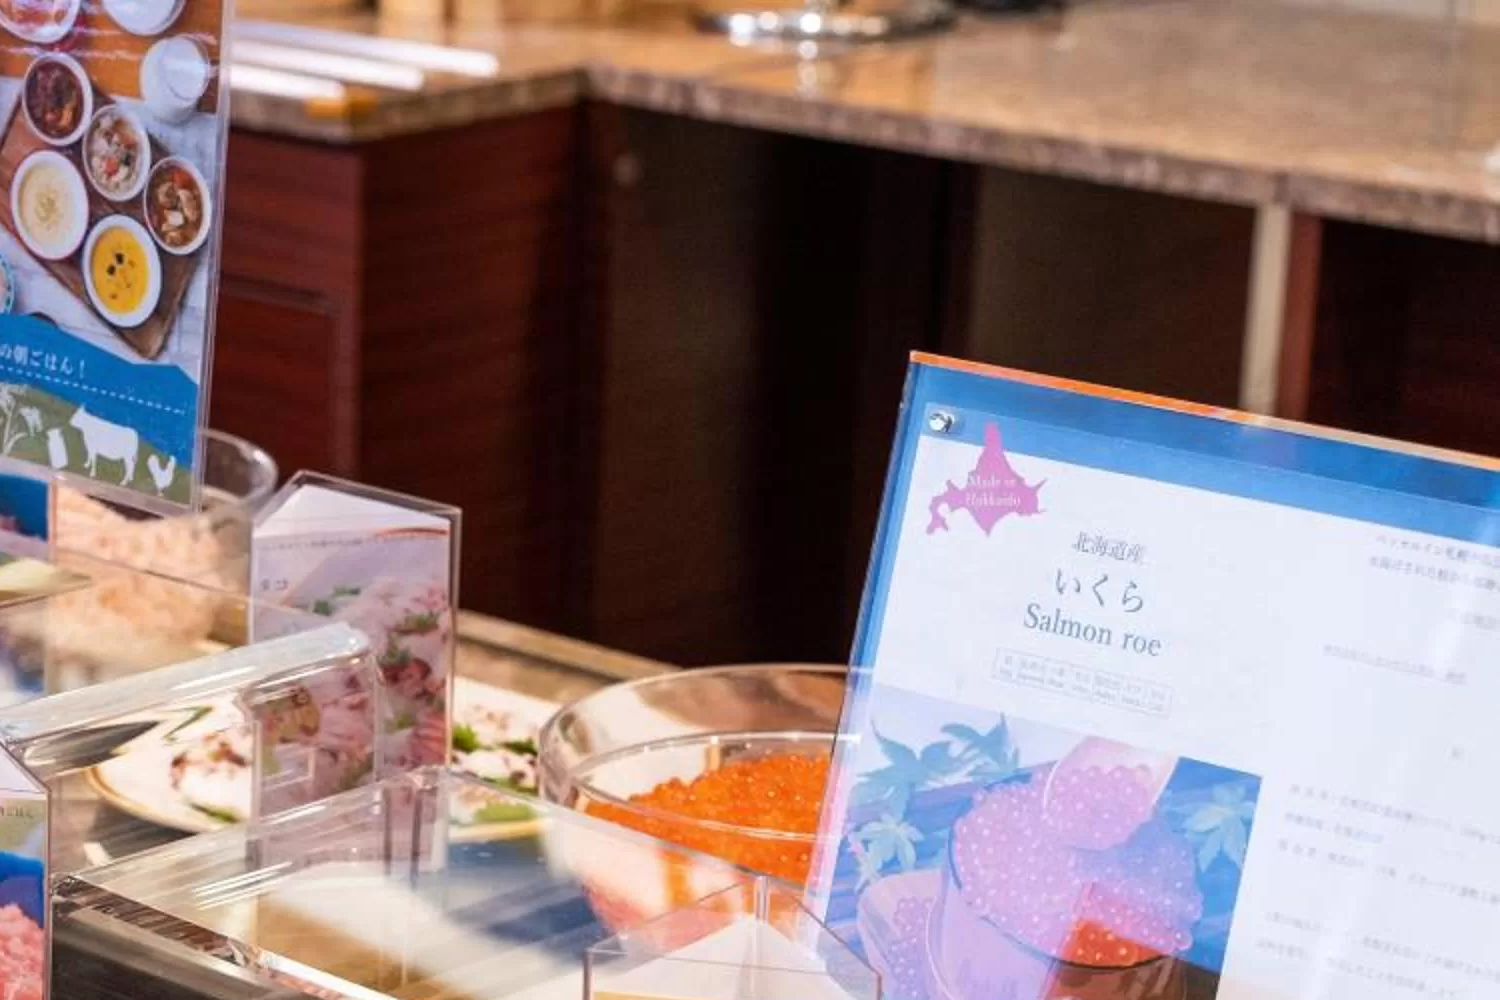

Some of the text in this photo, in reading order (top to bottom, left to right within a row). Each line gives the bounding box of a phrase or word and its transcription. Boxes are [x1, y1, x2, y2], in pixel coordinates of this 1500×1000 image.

[1072, 531, 1148, 564] 北海道産
[1054, 567, 1145, 613] いくら
[1022, 602, 1162, 658] Salmon roe
